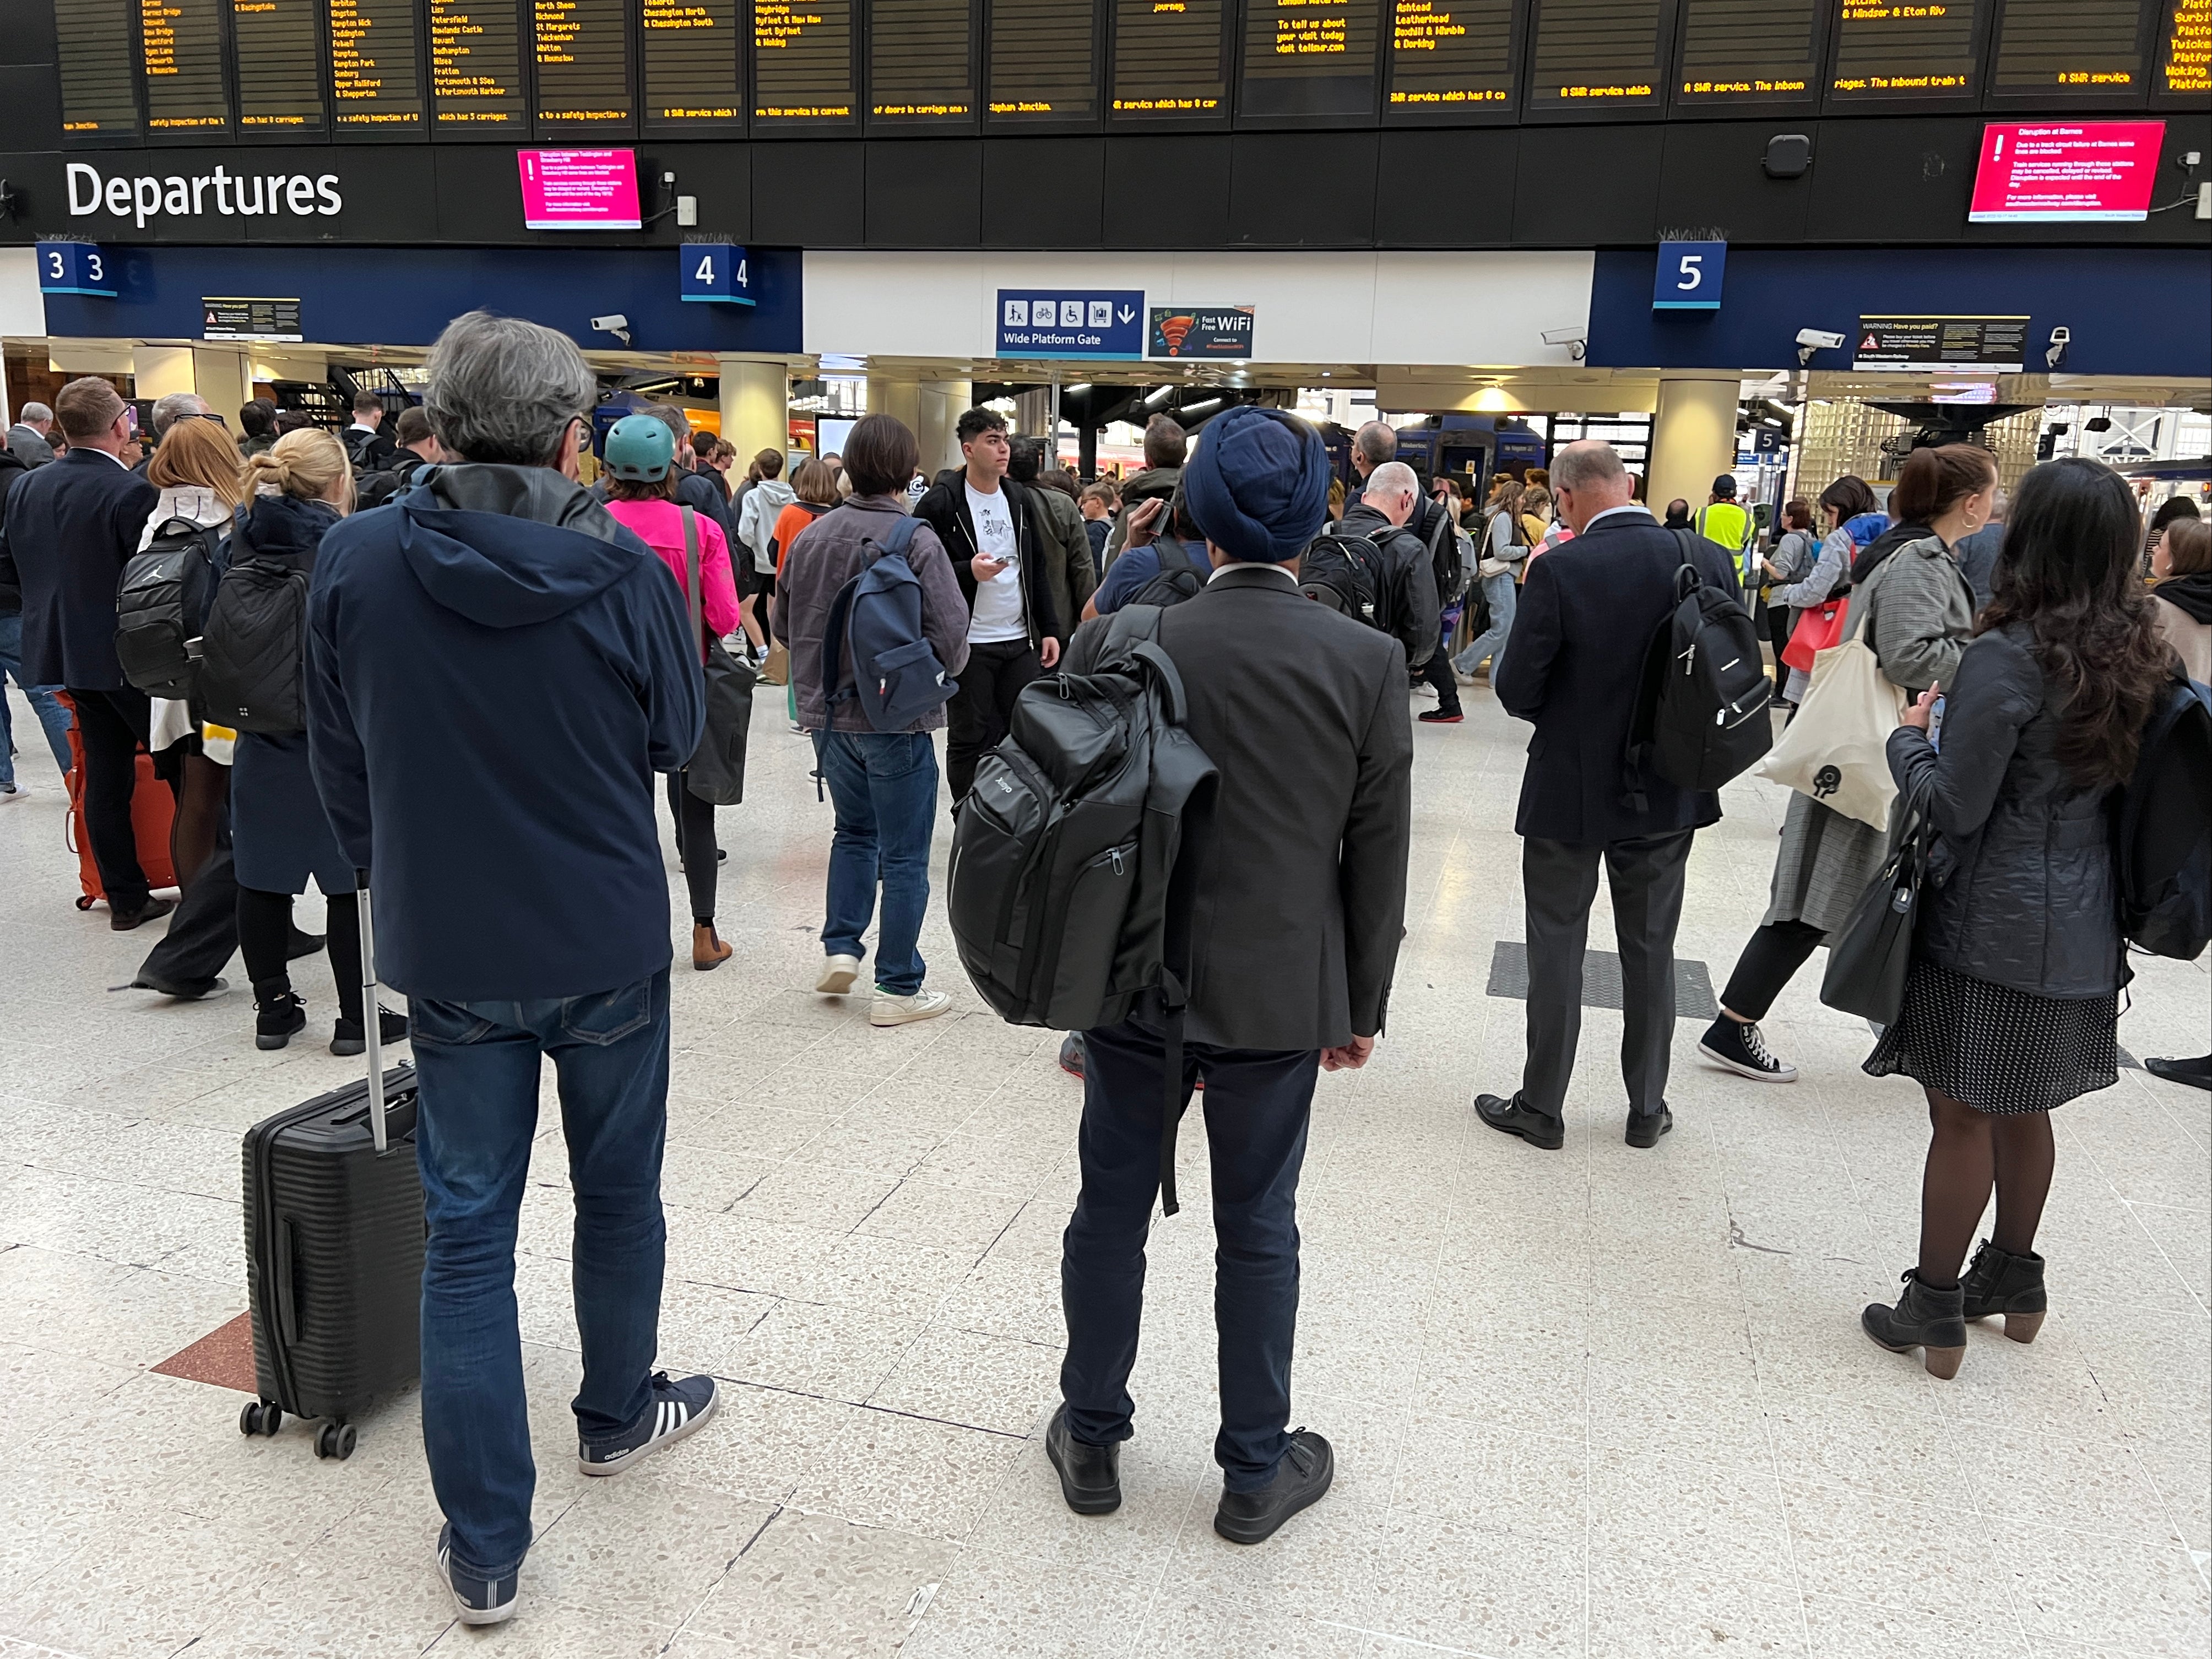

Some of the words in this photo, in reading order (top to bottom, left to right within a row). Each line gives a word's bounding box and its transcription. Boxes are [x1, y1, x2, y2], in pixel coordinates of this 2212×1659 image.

[535, 2, 555, 10] North
[556, 1, 576, 9] Sheen
[755, 4, 790, 15] Weybridge
[1153, 3, 1186, 13] journey.
[1396, 2, 1432, 13] Ashtead
[2183, 0, 2211, 8] Platf
[431, 6, 444, 14] Liss
[643, 8, 684, 18] Chessington
[685, 7, 706, 16] North
[1842, 8, 1850, 19] &
[1852, 7, 1890, 18] Windsor
[1892, 7, 1901, 17] &
[1903, 7, 1927, 17] Eton
[1929, 6, 1945, 16] Riv
[431, 15, 468, 24] Petersfield
[535, 12, 565, 20] Richmond
[755, 15, 782, 26] Byfleet
[1395, 13, 1450, 25] Leatherhead
[2175, 12, 2211, 22] Surbi
[536, 23, 545, 31] St
[546, 22, 581, 32] Margarets
[651, 19, 691, 29] Chessington
[692, 18, 713, 26] South
[1278, 20, 1289, 30] To
[1291, 19, 1308, 29] tell
[1309, 20, 1320, 29] us
[1321, 18, 1346, 28] about
[755, 27, 773, 36] West
[774, 26, 801, 37] Byfleet
[1277, 33, 1296, 44] your
[1298, 31, 1318, 41] visit
[1320, 30, 1345, 42] today
[1394, 26, 1424, 37] Boxhill
[1425, 26, 1433, 36] &
[763, 37, 787, 48] Woking
[1276, 44, 1295, 53] visit
[1298, 43, 1345, 53] tellswr.com
[1394, 39, 1401, 49] &
[1403, 38, 1435, 50] Dorking
[2172, 39, 2211, 49] Twicke
[2166, 66, 2206, 77] Woking
[434, 77, 471, 85] Portsmouth
[1834, 79, 1867, 90] riages.
[1871, 77, 1889, 88] The
[1891, 76, 1928, 87] inbound
[1931, 75, 1956, 86] train
[2058, 73, 2067, 83] A
[2069, 72, 2089, 83] SWR
[2091, 72, 2130, 83] service
[442, 88, 479, 96] Portsmouth
[1560, 87, 1569, 97] A
[1569, 86, 1588, 97] SWR
[1588, 86, 1624, 96] service
[1625, 85, 1651, 95] which
[1684, 83, 1691, 93] A
[1693, 82, 1712, 93] SWR
[1714, 82, 1751, 92] service.
[1754, 80, 1772, 91] The
[1774, 80, 1804, 90] inboun
[1407, 92, 1440, 102] service
[1442, 91, 1466, 101] which
[1467, 91, 1484, 100] has
[1494, 91, 1506, 100] ca
[989, 102, 1016, 113] lapham
[1017, 102, 1051, 111] Junction.
[1123, 100, 1153, 109] service
[1154, 99, 1177, 109] which
[1178, 99, 1192, 108] has
[562, 111, 584, 120] safety
[586, 111, 619, 120] inspection
[686, 109, 712, 117] service
[713, 109, 732, 117] which
[767, 107, 782, 116] this
[783, 107, 811, 116] service
[811, 107, 819, 116] is
[820, 106, 849, 116] current
[873, 106, 883, 114] of
[884, 105, 906, 114] doors
[907, 105, 914, 113] in
[916, 105, 947, 115] carriage
[349, 115, 369, 123] safety
[477, 113, 508, 121] carriages.
[66, 163, 342, 228] Departures
[48, 252, 63, 279] 3
[87, 254, 103, 280] 3
[695, 256, 714, 285] 4
[736, 259, 747, 288] 4
[1677, 256, 1702, 290] 5
[1217, 316, 1251, 330] WiFi
[1004, 333, 1029, 344] Wide
[1032, 333, 1075, 344] Platform
[1077, 334, 1101, 345] Gate
[1762, 433, 1773, 447] 5
[604, 1448, 630, 1460] adidas
